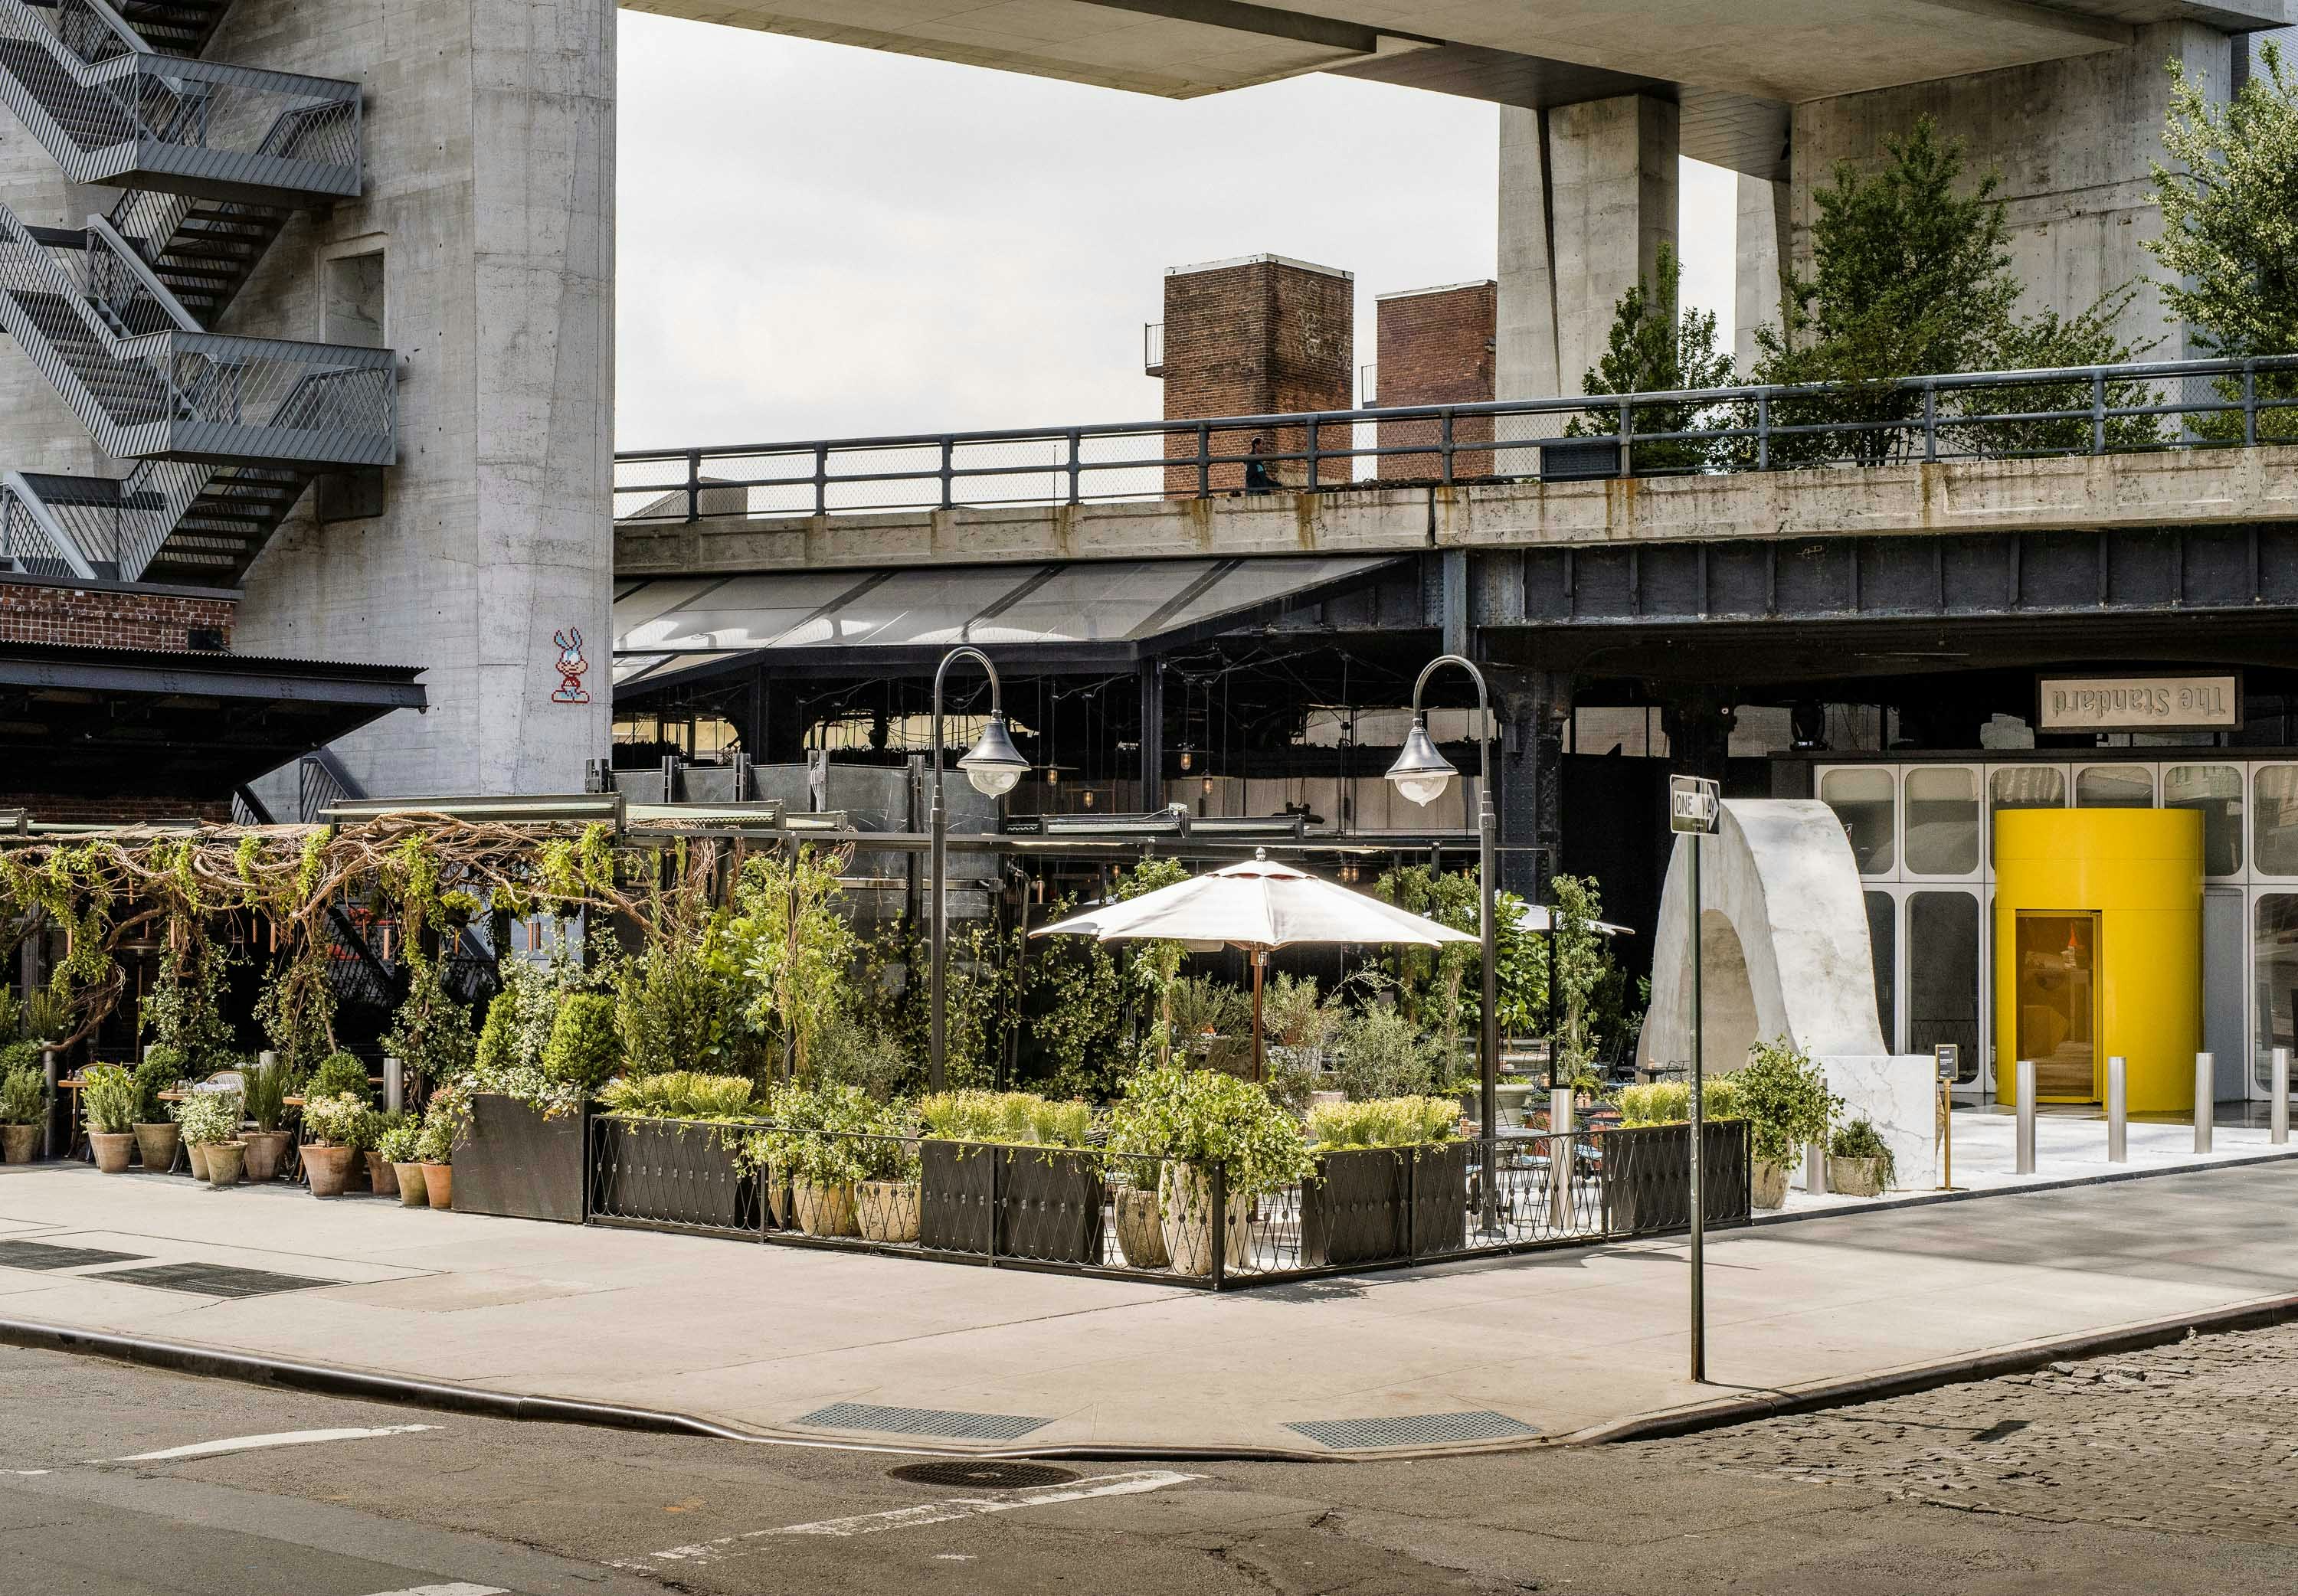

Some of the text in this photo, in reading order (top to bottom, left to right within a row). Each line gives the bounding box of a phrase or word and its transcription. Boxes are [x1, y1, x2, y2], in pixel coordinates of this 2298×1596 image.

[2052, 687, 2225, 718] The Standard
[1675, 793, 1716, 819] ONE WAY
